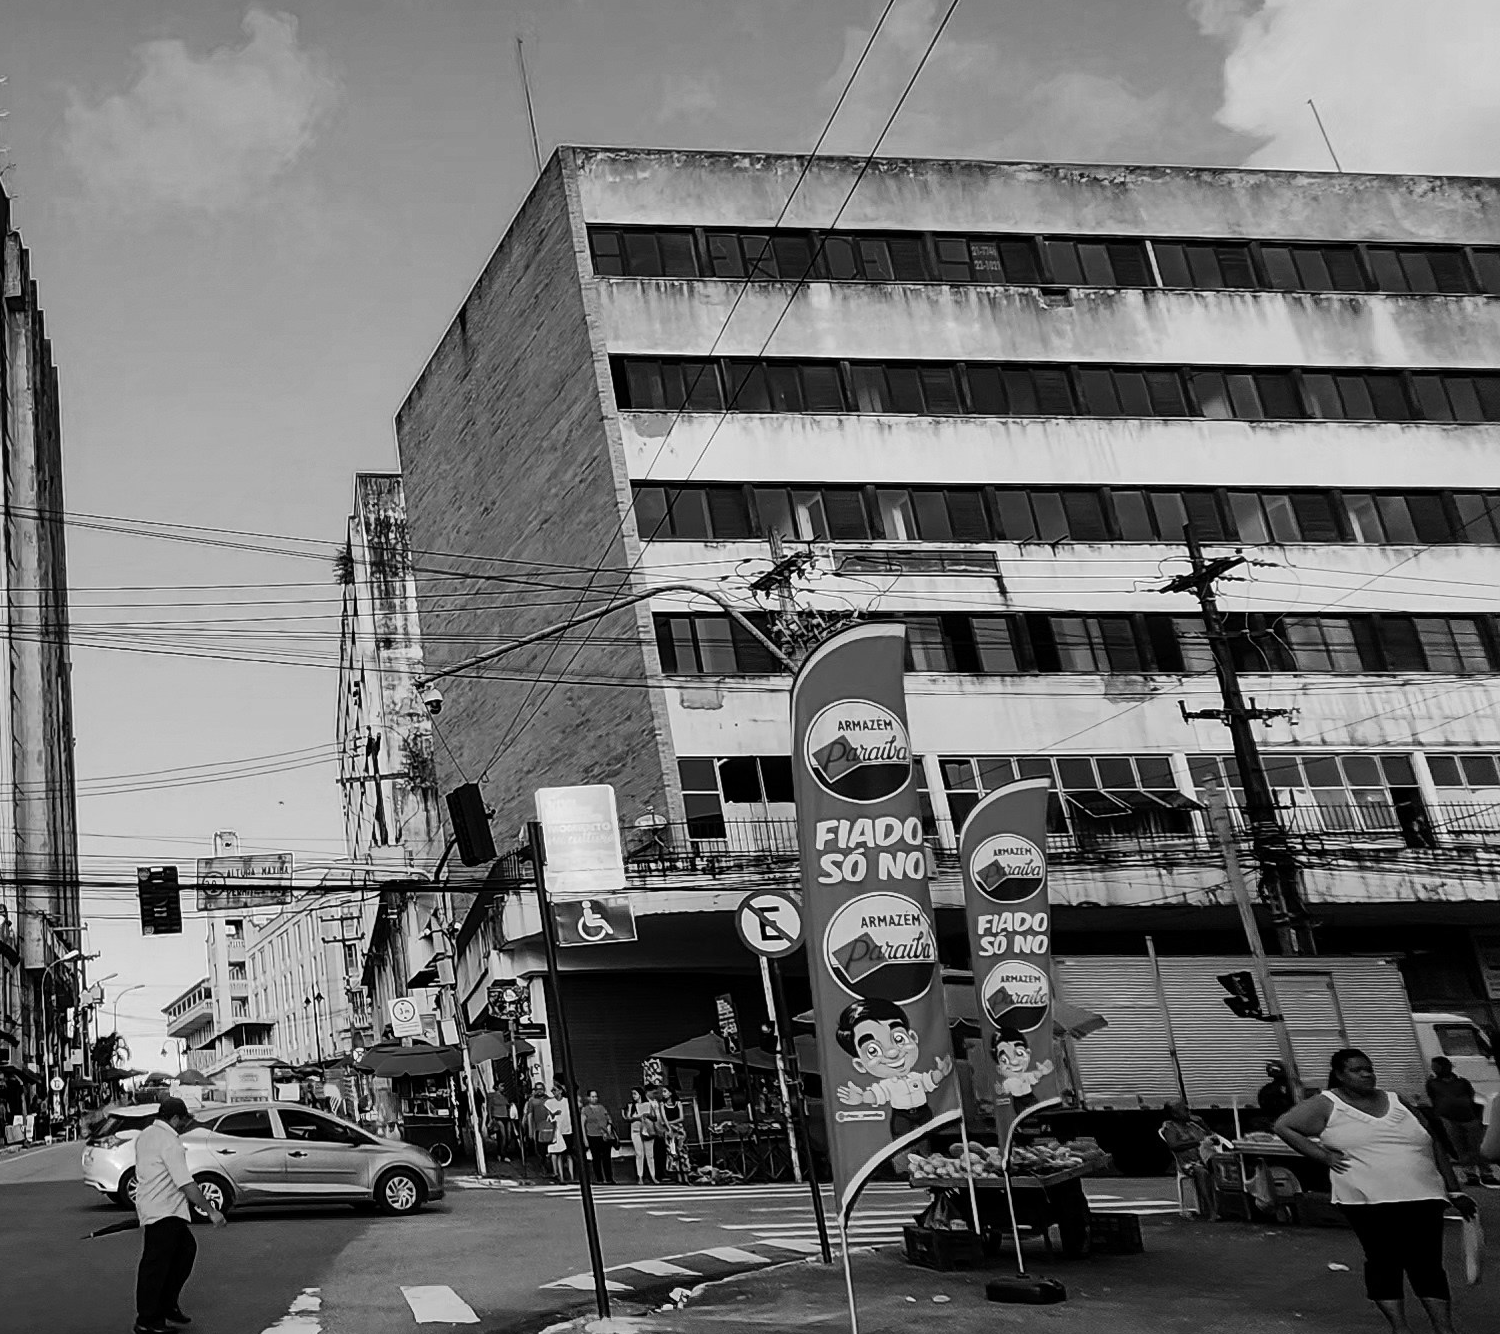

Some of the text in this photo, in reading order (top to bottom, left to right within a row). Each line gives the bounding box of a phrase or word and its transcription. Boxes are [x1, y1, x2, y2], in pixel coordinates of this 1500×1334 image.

[837, 716, 893, 732] ARMAZÉM
[815, 816, 923, 851] FIADO
[817, 848, 925, 884] SÓ NO
[860, 910, 921, 929] ARMAZÉM
[977, 911, 1048, 935] FIADO
[978, 931, 1048, 956] SÓ NO
